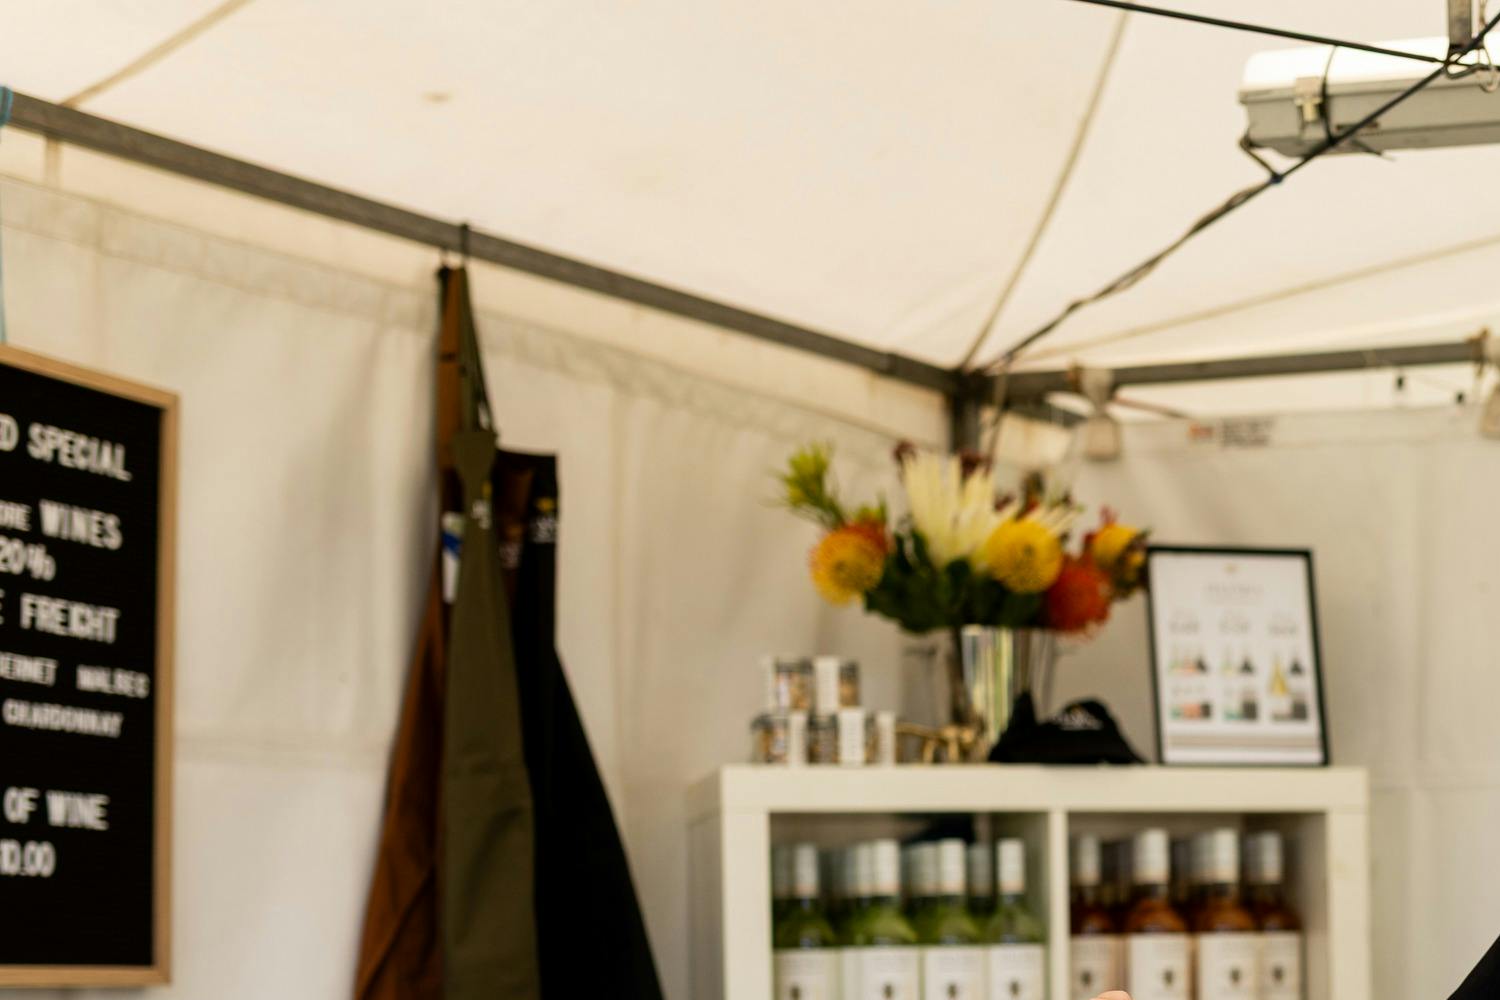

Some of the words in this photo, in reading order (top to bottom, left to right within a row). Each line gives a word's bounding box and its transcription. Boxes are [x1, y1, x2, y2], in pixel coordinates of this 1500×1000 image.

[27, 422, 133, 482] SPECIAL
[39, 499, 122, 550] WINES
[20, 592, 120, 643] FREIGHT
[76, 664, 150, 699] MALBEC
[2, 698, 124, 738] CHARDONNAY
[3, 786, 40, 824] OF
[46, 789, 110, 831] WINE
